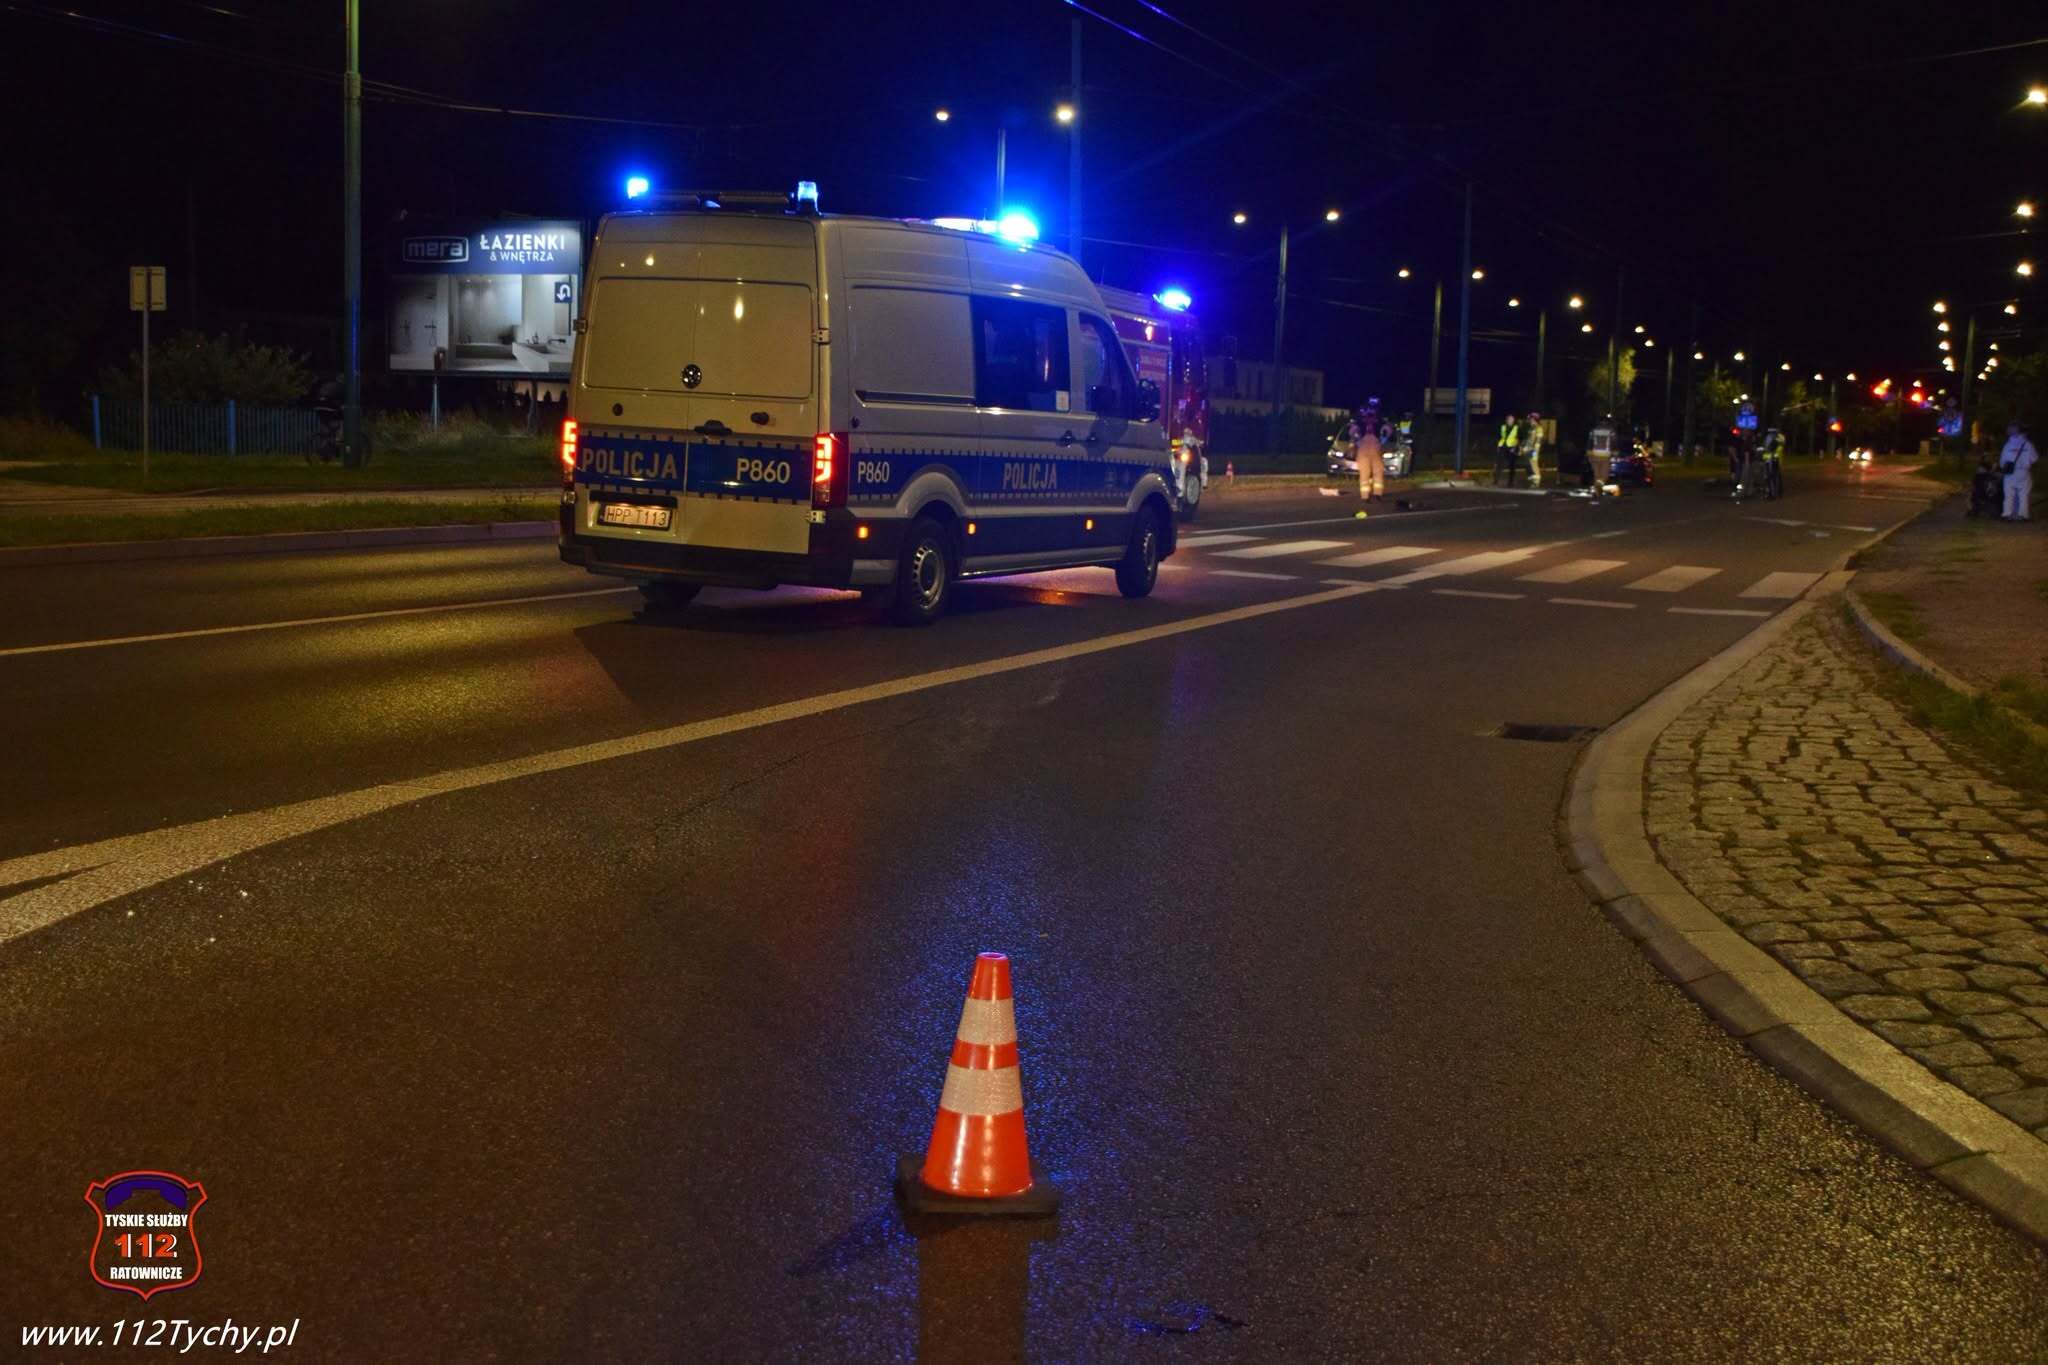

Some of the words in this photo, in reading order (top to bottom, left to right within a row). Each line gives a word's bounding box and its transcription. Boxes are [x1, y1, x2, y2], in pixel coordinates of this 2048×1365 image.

[407, 242, 464, 257] mera
[480, 234, 565, 250] ŁAZIENKI
[489, 252, 497, 262] &
[501, 251, 554, 264] WNĘTRZA
[582, 449, 677, 479] POLICJA
[736, 457, 791, 484] P860
[857, 461, 890, 484] P860
[1003, 464, 1057, 490] POLICJA
[607, 507, 631, 522] HPP
[636, 509, 667, 526] T113
